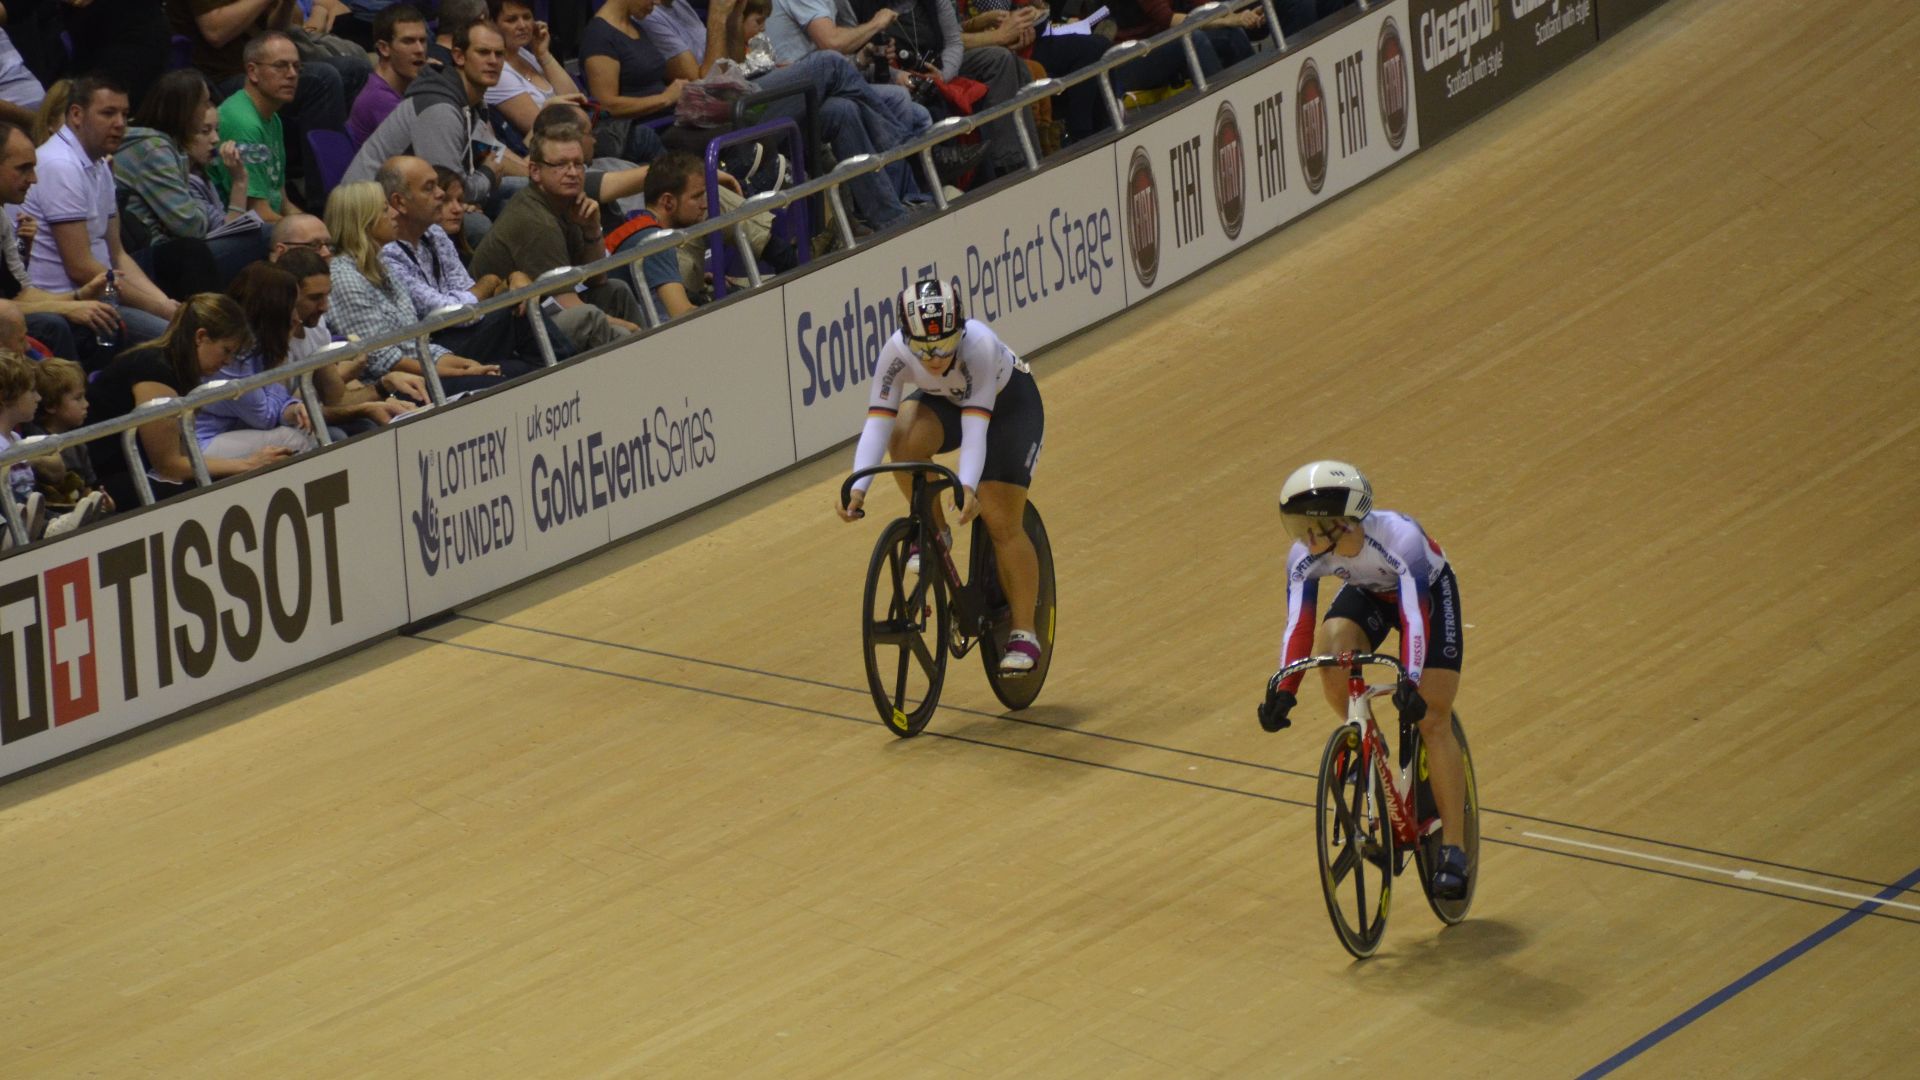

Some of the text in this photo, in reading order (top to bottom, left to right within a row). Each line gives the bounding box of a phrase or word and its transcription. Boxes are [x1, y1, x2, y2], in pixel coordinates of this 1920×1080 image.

[1335, 49, 1367, 159] FIAT
[1446, 60, 1473, 98] Scotland
[1169, 134, 1204, 249] FIAT
[1254, 91, 1286, 203] FIAT
[967, 224, 1048, 322] Perfect
[1050, 207, 1113, 295] Stage
[437, 426, 507, 498] LOTTERY
[527, 390, 581, 442] uk sport
[98, 469, 350, 702] TISSOT
[443, 494, 514, 569] FUNDED
